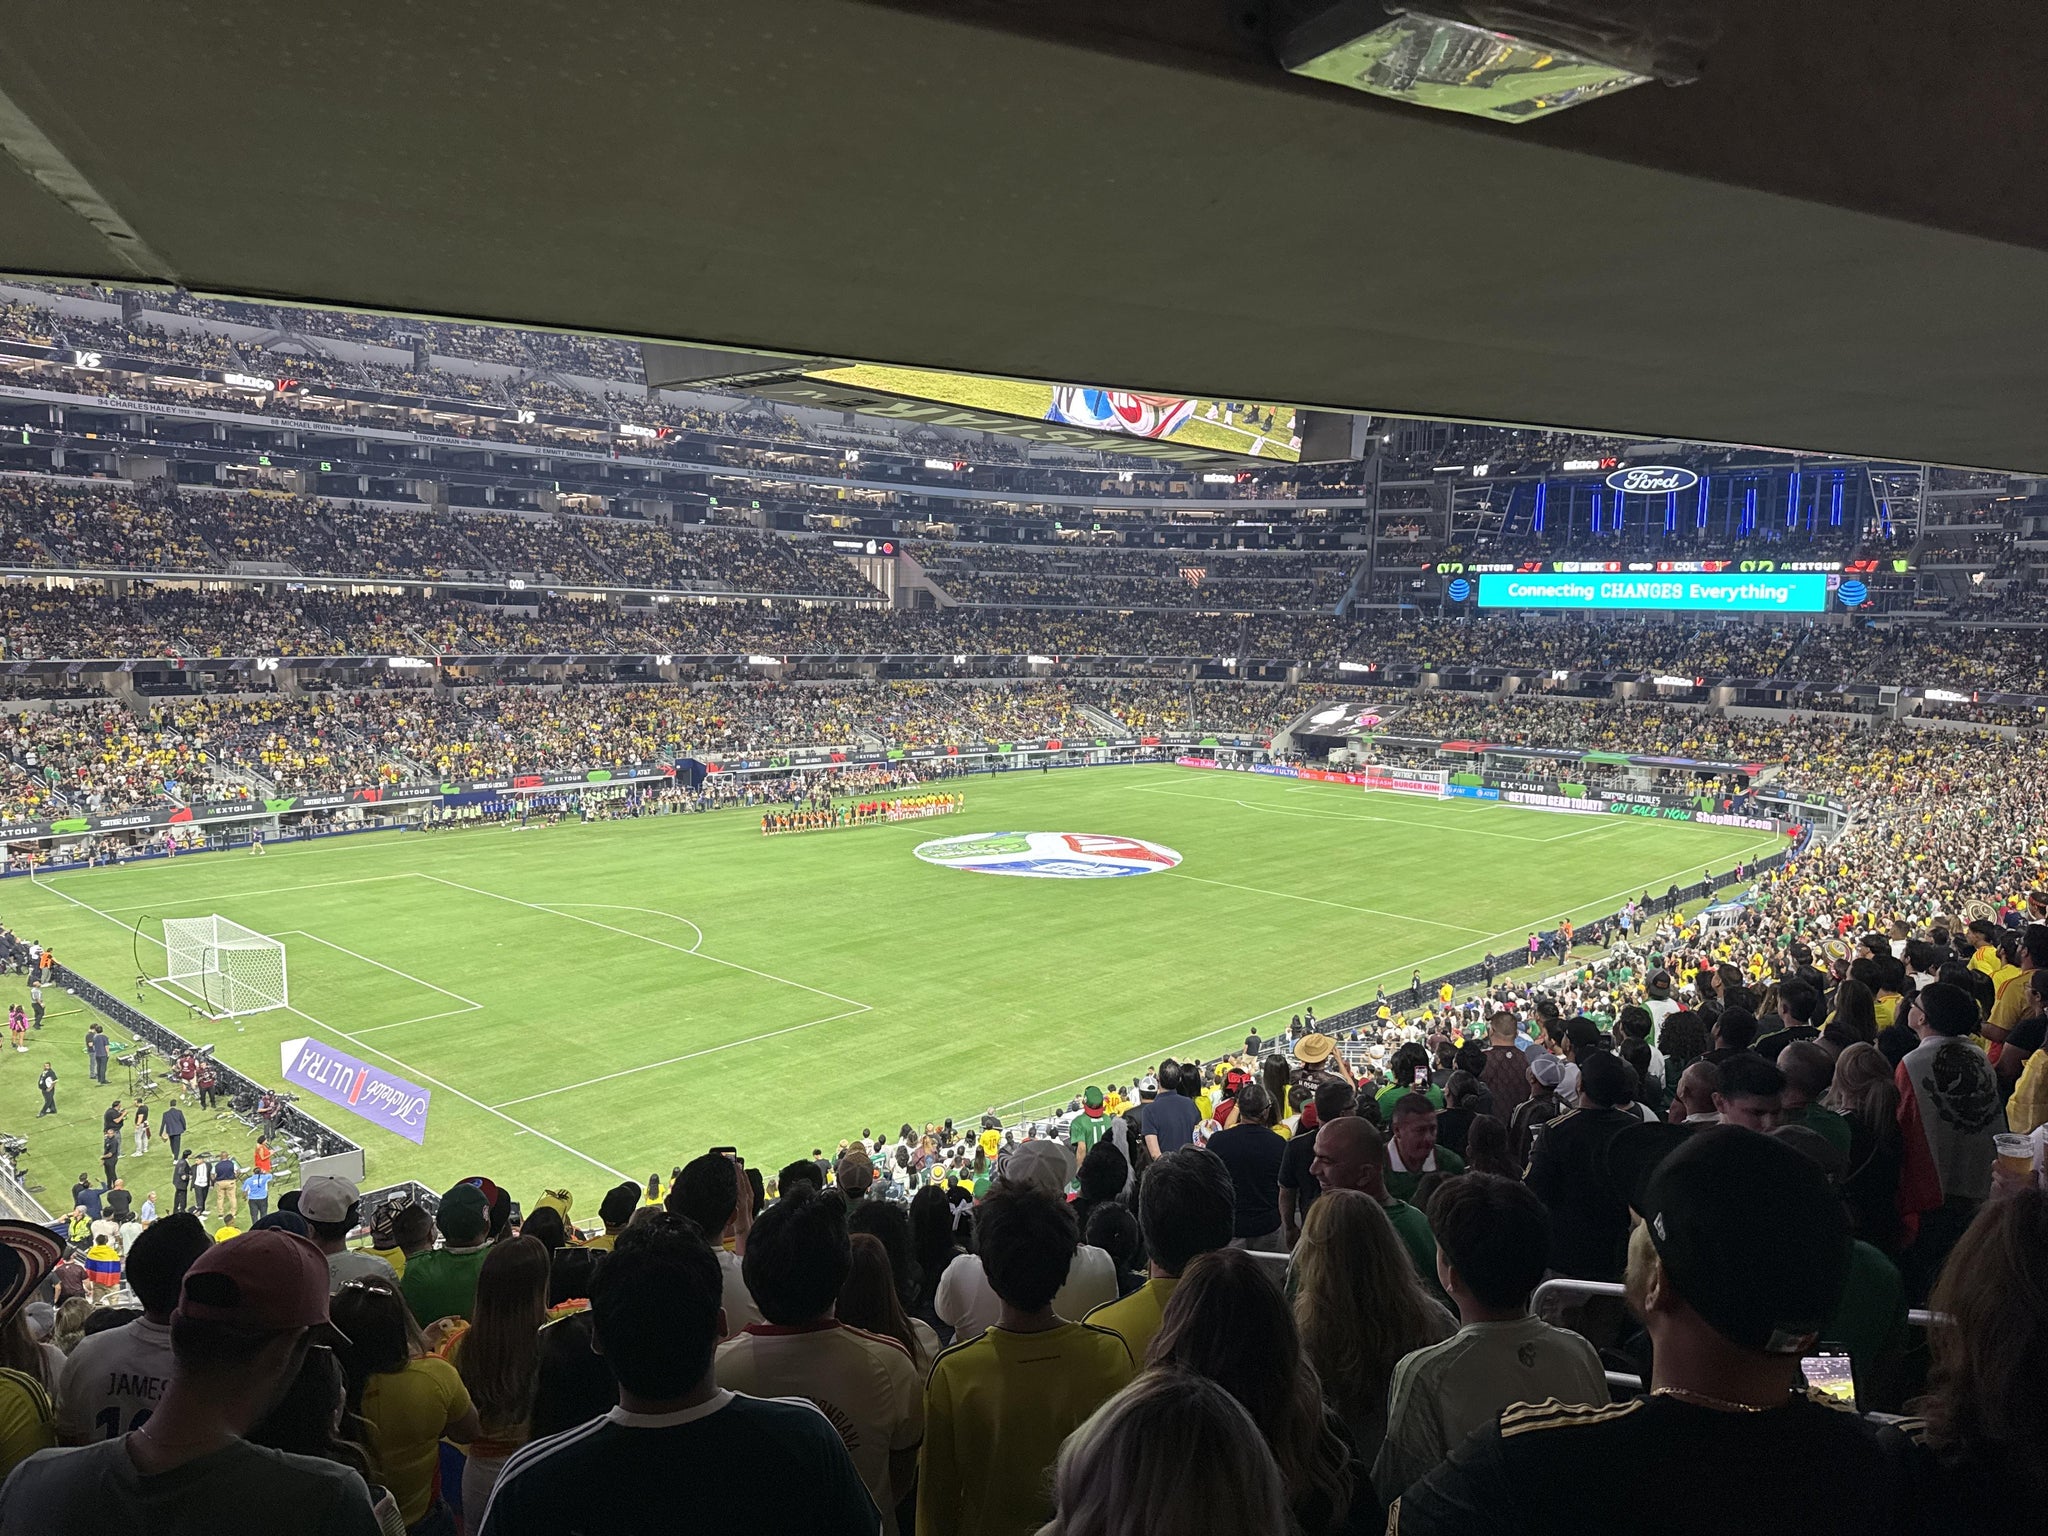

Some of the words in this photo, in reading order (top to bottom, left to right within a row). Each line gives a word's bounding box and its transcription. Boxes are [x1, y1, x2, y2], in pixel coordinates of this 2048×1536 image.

[75, 351, 102, 368] VS
[97, 398, 108, 407] 94
[110, 400, 149, 411] CHARLES
[150, 405, 176, 414] HALEY
[518, 410, 536, 424] VS
[281, 420, 311, 429] MICHAEL
[313, 423, 331, 431] IRVIN
[855, 402, 1222, 462] WINSTAR
[436, 437, 460, 445] AIKMAN
[845, 450, 859, 462] VS
[1118, 471, 1132, 482] VS
[1473, 464, 1489, 477] VS
[1623, 470, 1679, 490] Ford
[1468, 563, 1513, 572] MEXTOUR
[1674, 562, 1698, 572] COL
[1781, 562, 1840, 571] MEXTOUR
[1508, 583, 1594, 600] Connecting
[1601, 583, 1683, 599] CHANGES
[257, 657, 280, 671] VS
[656, 655, 673, 665] VS
[1552, 670, 1569, 681] VS
[637, 768, 650, 776] AT&T
[1279, 767, 1298, 777] ULTRA
[1394, 780, 1422, 790] BURGER
[392, 788, 430, 797] MEXTOUR
[1484, 790, 1496, 798] AT&T
[1509, 792, 1528, 804] GET
[1528, 793, 1547, 806] YOUR
[1548, 795, 1571, 809] GEAR
[1571, 798, 1603, 812] TODAY!
[1634, 794, 1661, 806] LOCALES
[207, 805, 252, 814] MEXTOUR
[1610, 803, 1628, 814] ON
[1632, 804, 1658, 818] SALE
[1663, 807, 1691, 821] NOW
[1696, 811, 1772, 831] ShopMNT.com
[0, 827, 38, 838] XTOUR
[297, 1049, 354, 1094] ULTRA
[361, 1080, 426, 1126] Michelob
